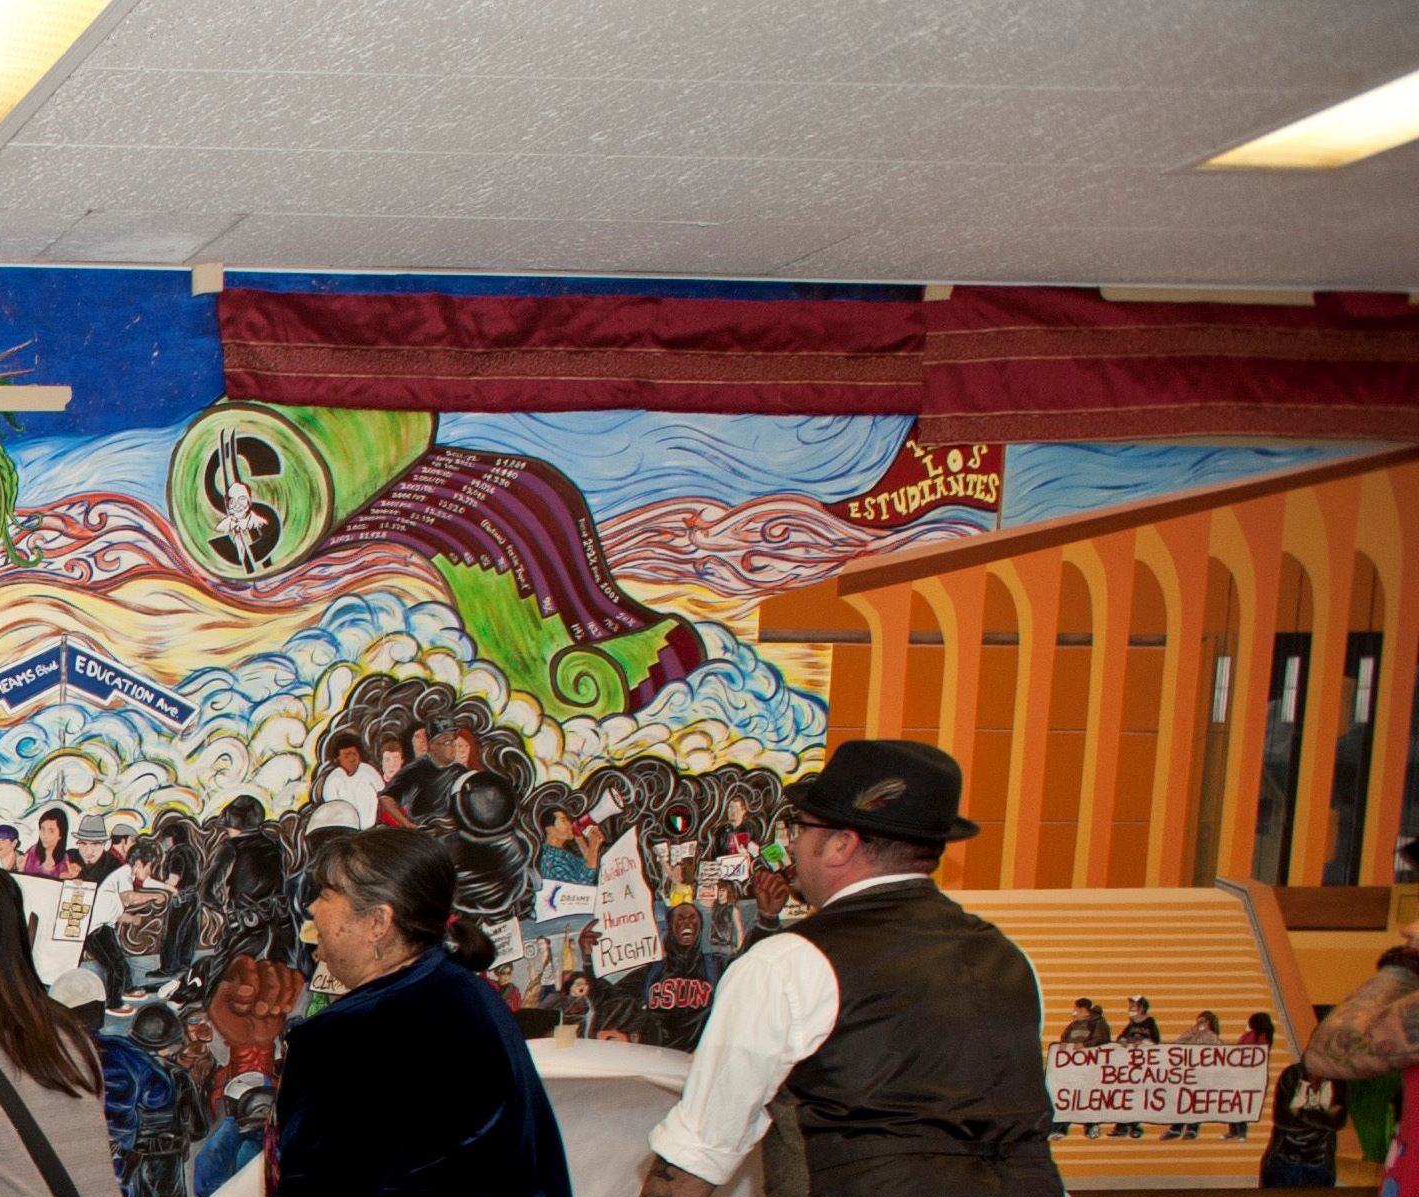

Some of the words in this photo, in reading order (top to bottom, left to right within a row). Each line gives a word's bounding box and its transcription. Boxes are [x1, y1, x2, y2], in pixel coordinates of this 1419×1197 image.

[921, 444, 989, 478] LOS
[848, 472, 1000, 521] ESTUDIANTES
[74, 654, 155, 705] EDUCATION
[624, 884, 635, 900] A
[603, 911, 645, 930] Human
[599, 934, 658, 968] RIGHT!
[648, 977, 713, 1010] CSUN
[1055, 1047, 1116, 1068] DON'T
[1128, 1047, 1160, 1066] BE
[1168, 1046, 1267, 1068] SILENCED
[1101, 1064, 1198, 1085] BECAUSE
[1054, 1088, 1135, 1112] SILENCE
[1144, 1088, 1167, 1112] IS
[1176, 1086, 1262, 1115] DEFEAT
